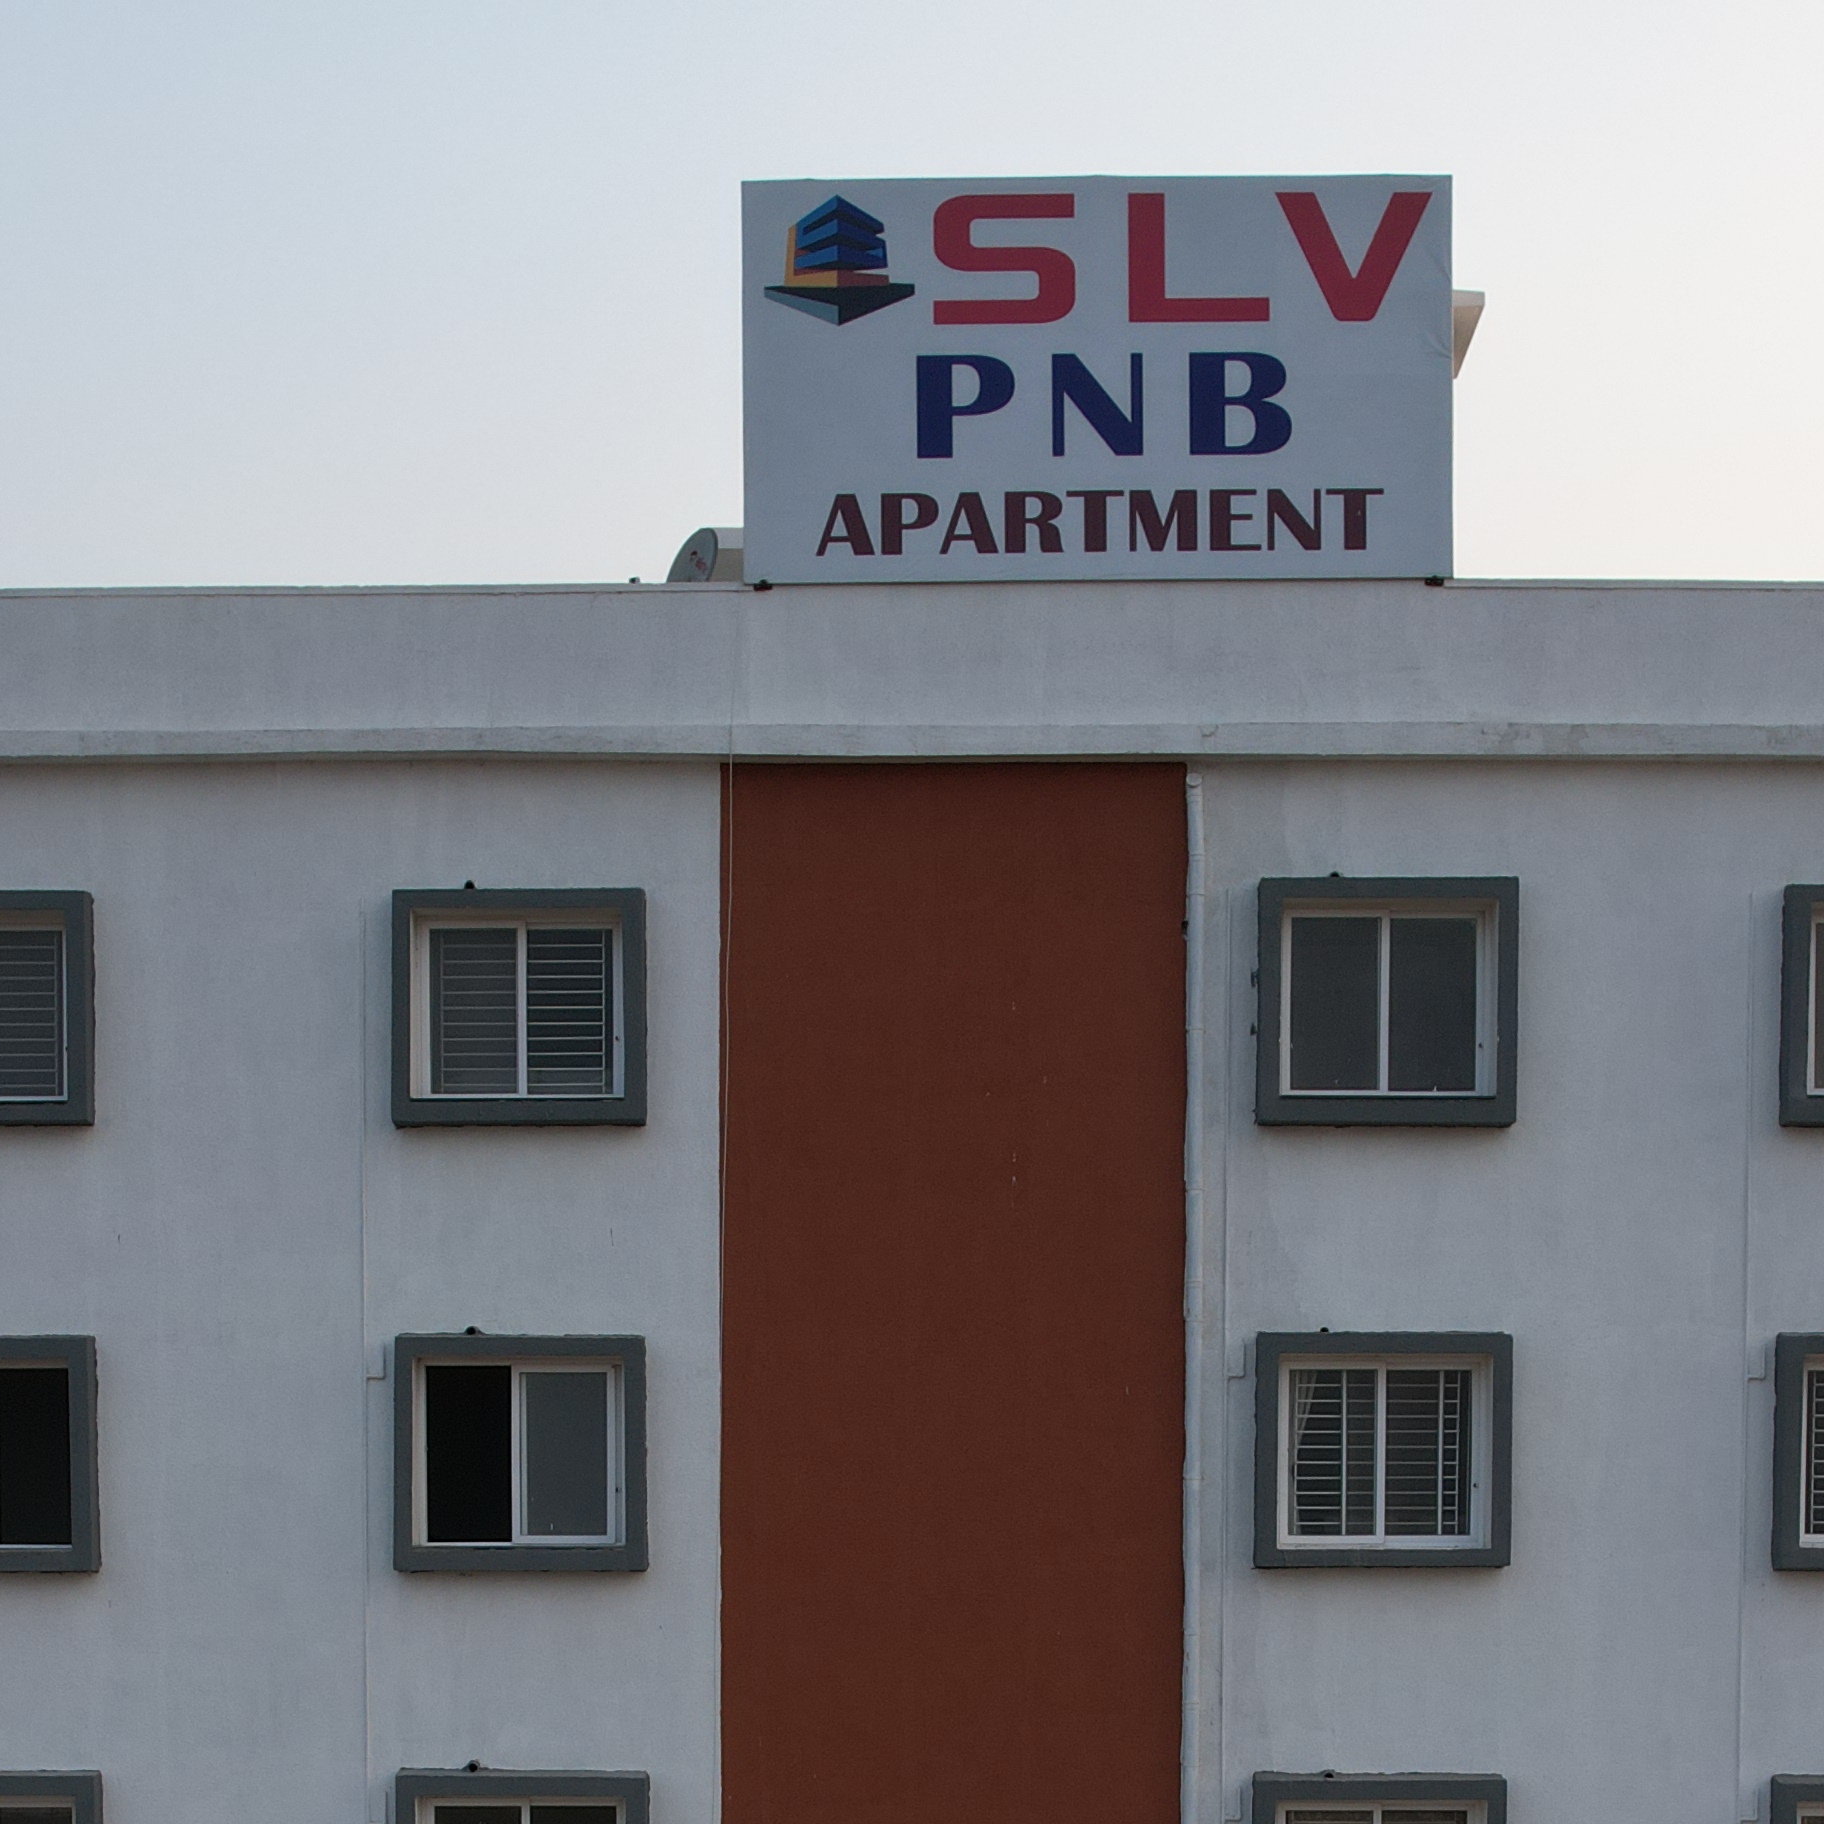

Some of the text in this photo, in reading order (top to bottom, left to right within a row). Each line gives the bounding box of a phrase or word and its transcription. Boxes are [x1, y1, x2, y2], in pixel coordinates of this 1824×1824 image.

[933, 191, 1433, 326] SLV
[915, 351, 1293, 459] PNB
[815, 487, 1385, 557] APARTMENT
